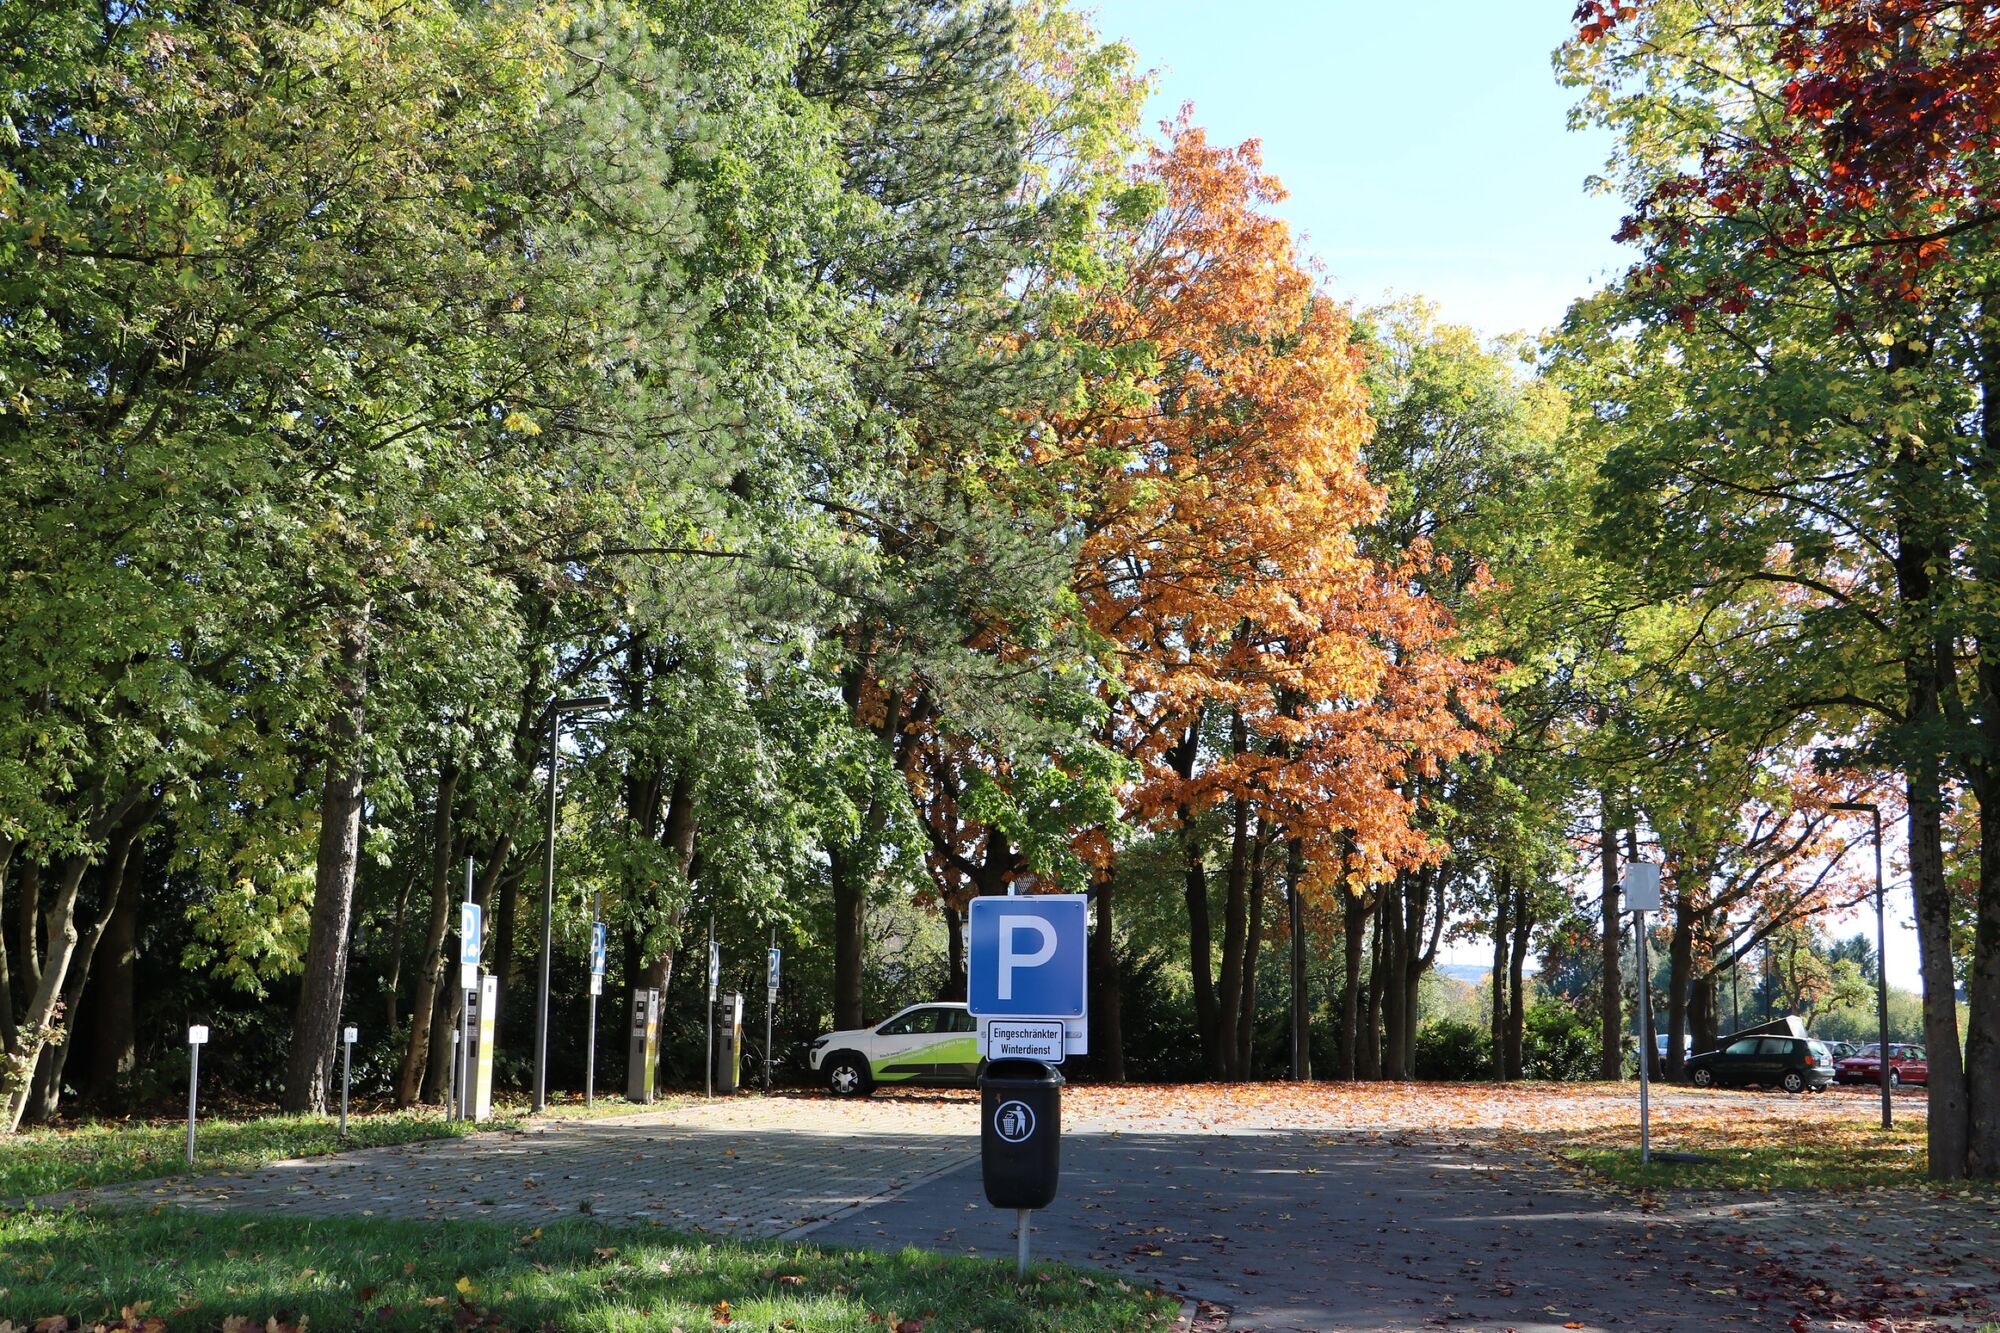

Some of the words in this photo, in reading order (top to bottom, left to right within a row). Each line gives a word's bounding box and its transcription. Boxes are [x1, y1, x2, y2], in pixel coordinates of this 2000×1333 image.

[462, 909, 475, 958] P
[998, 915, 1058, 1000] P
[994, 1027, 1058, 1041] Eingeschränkter
[1001, 1043, 1051, 1055] Winterdienst
